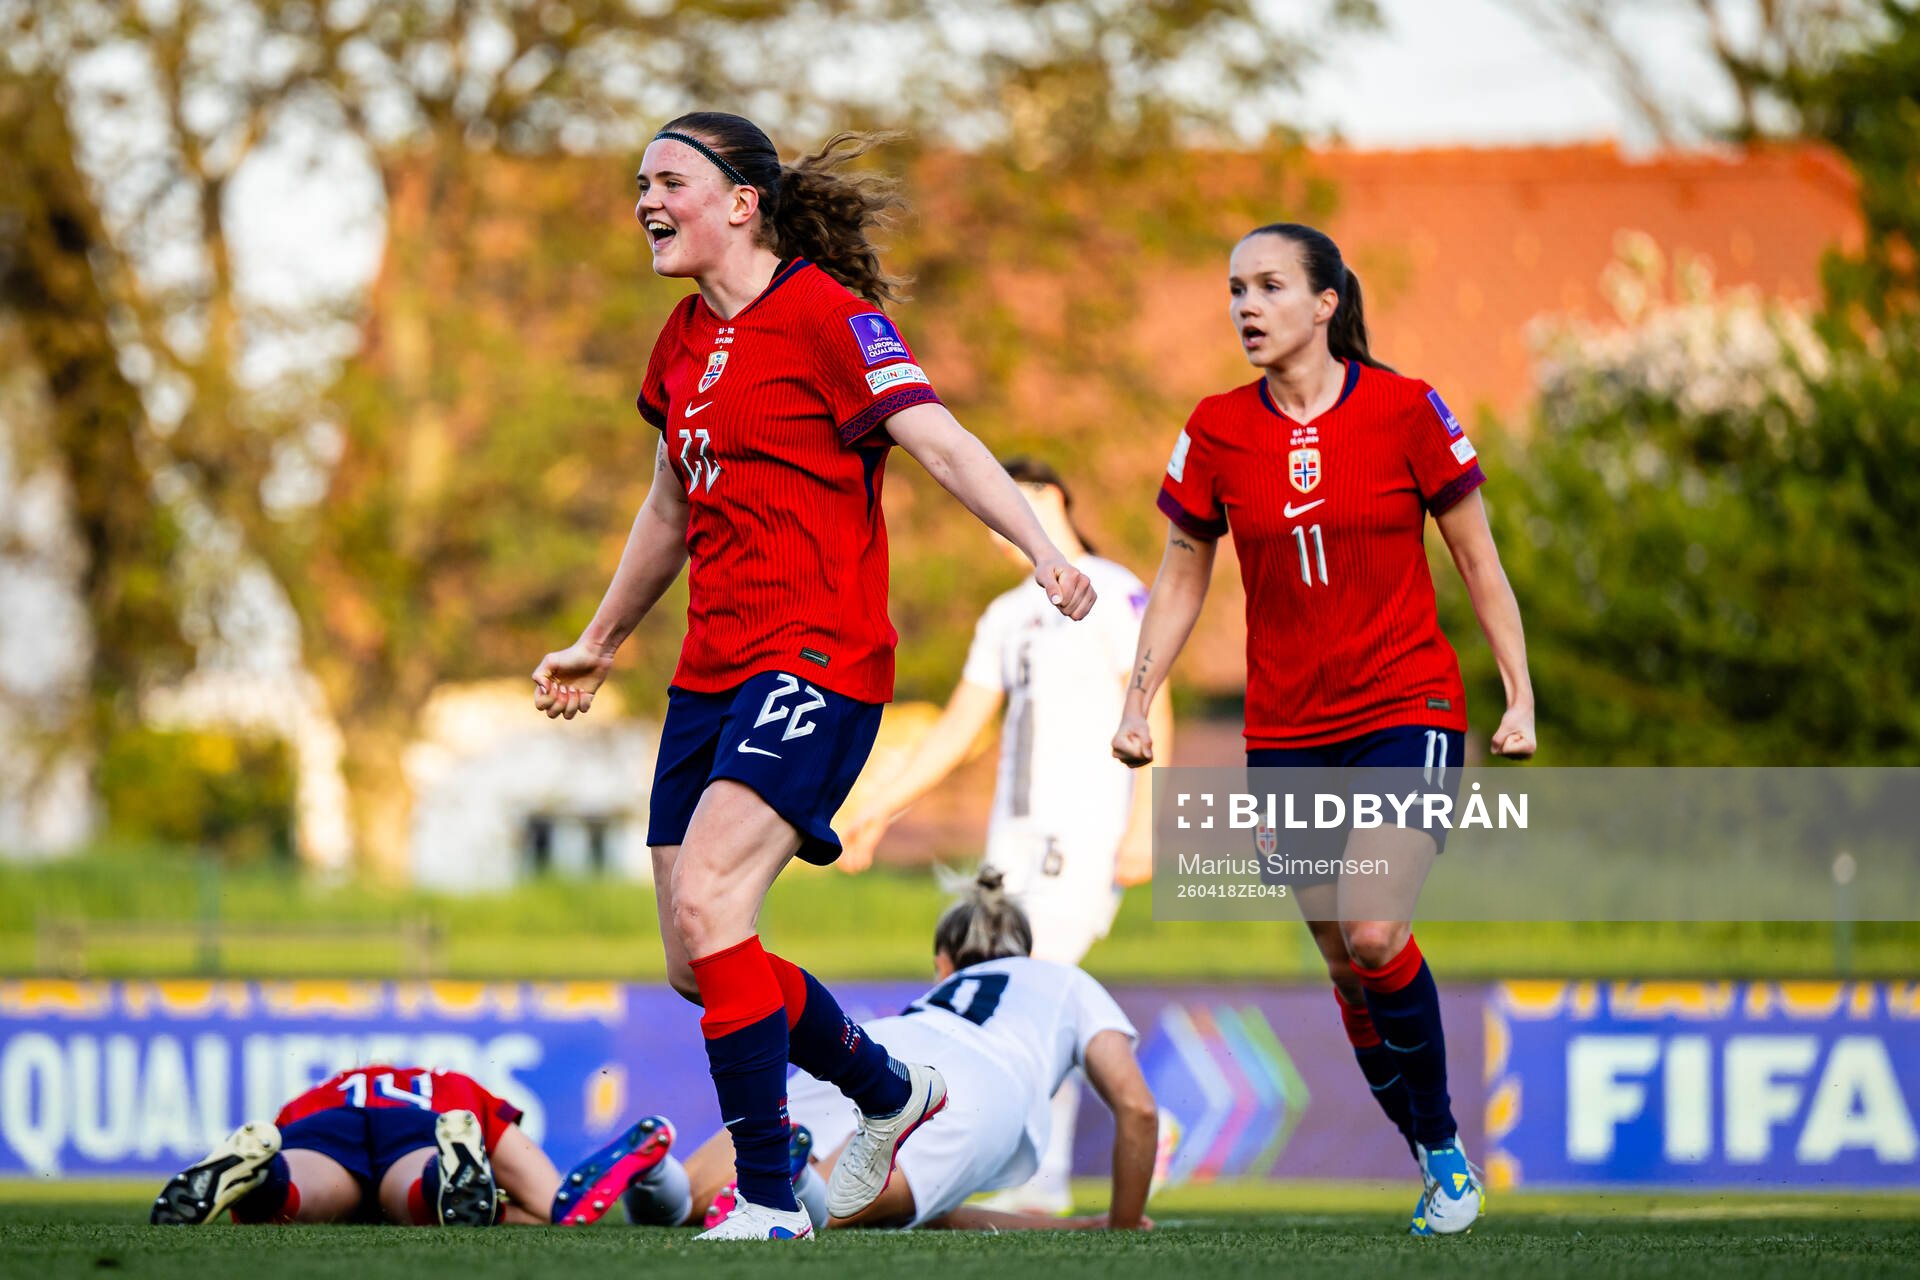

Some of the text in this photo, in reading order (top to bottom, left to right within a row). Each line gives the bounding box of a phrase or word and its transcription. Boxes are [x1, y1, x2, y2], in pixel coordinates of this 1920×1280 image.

[679, 428, 721, 495] 22
[1291, 524, 1328, 588] 11
[753, 673, 826, 741] 22
[1424, 729, 1448, 790] 11
[1565, 1034, 1918, 1164] FIFA
